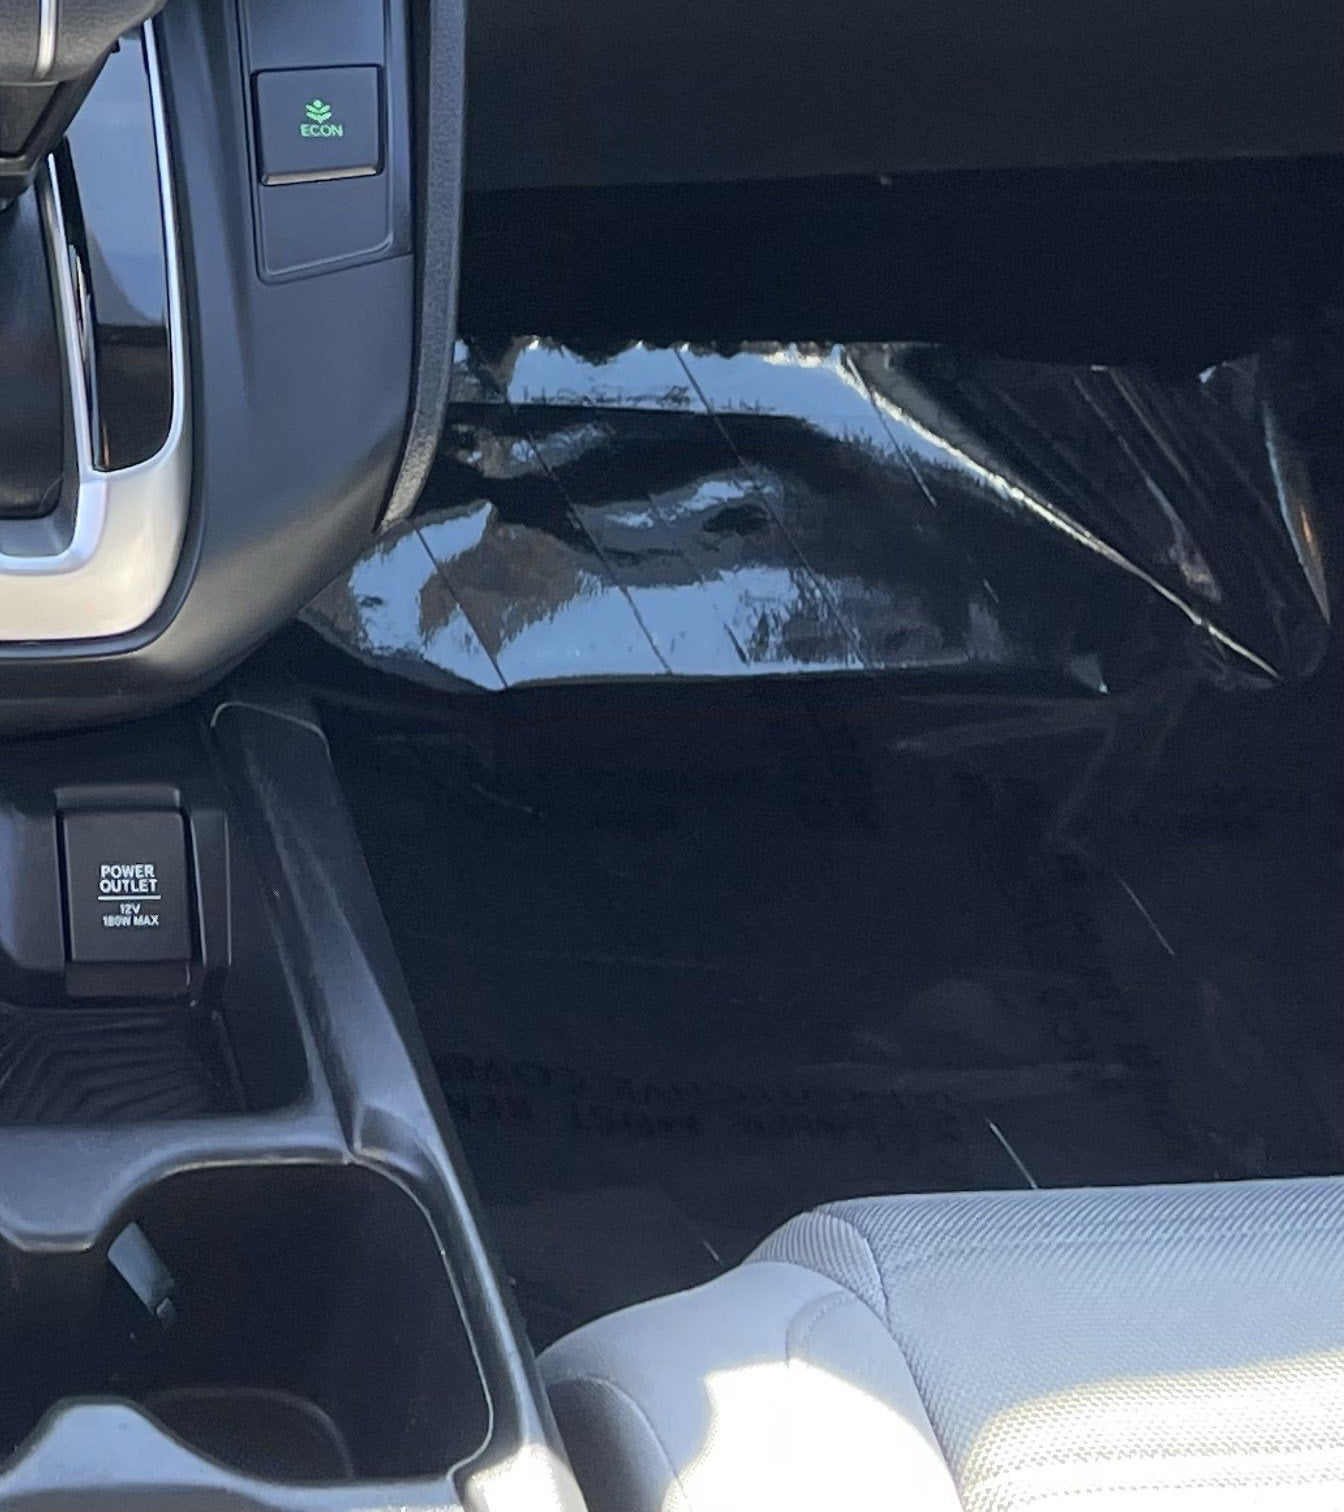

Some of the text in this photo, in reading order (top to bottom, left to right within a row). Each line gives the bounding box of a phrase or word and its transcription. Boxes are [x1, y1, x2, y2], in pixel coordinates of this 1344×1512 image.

[300, 124, 344, 138] ECON
[100, 864, 155, 879] POWER
[99, 878, 158, 893] OUTLET
[119, 903, 142, 915] 12V
[133, 914, 160, 926] MAX
